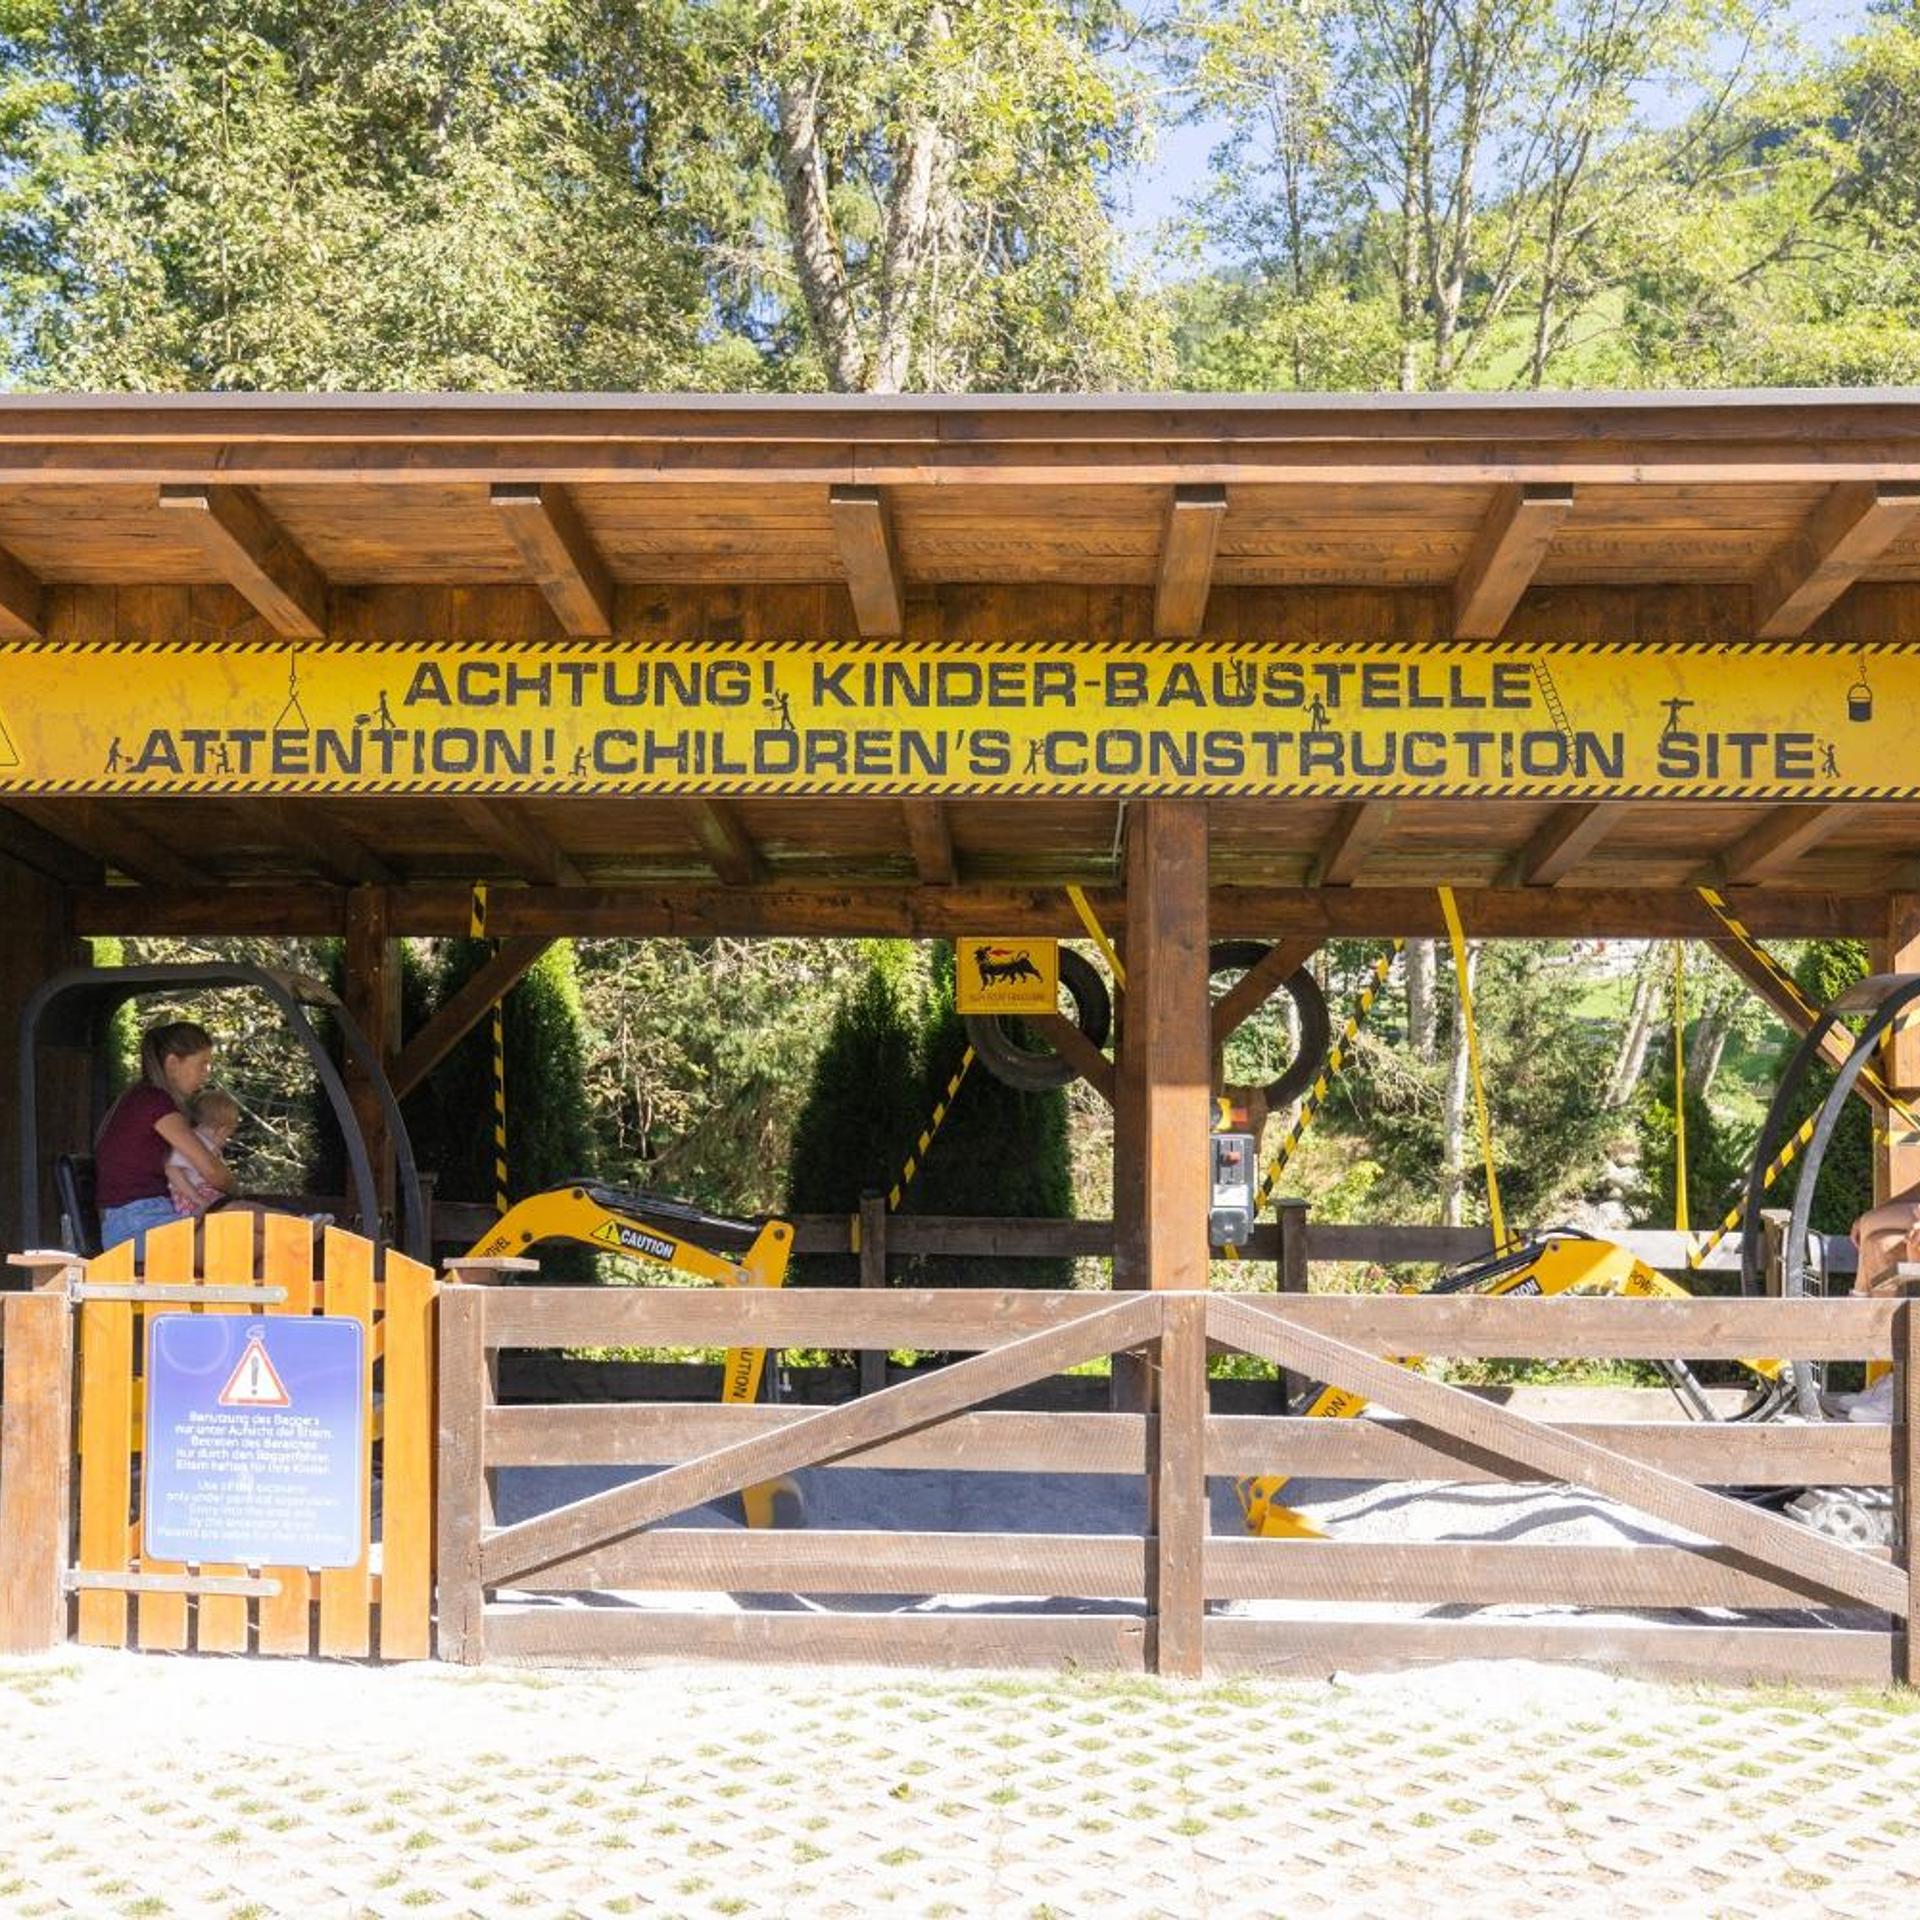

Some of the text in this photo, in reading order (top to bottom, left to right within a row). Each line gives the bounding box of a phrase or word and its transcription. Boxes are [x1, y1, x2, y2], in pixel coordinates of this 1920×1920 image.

[405, 661, 1531, 709] ACHTUNG! KINDER-BAUSTELLE
[131, 728, 1815, 780] ATTENTION! CHILDREN'S CONSTRUCTION SITE
[621, 1229, 674, 1258] CAUTION
[732, 1347, 754, 1398] UTION
